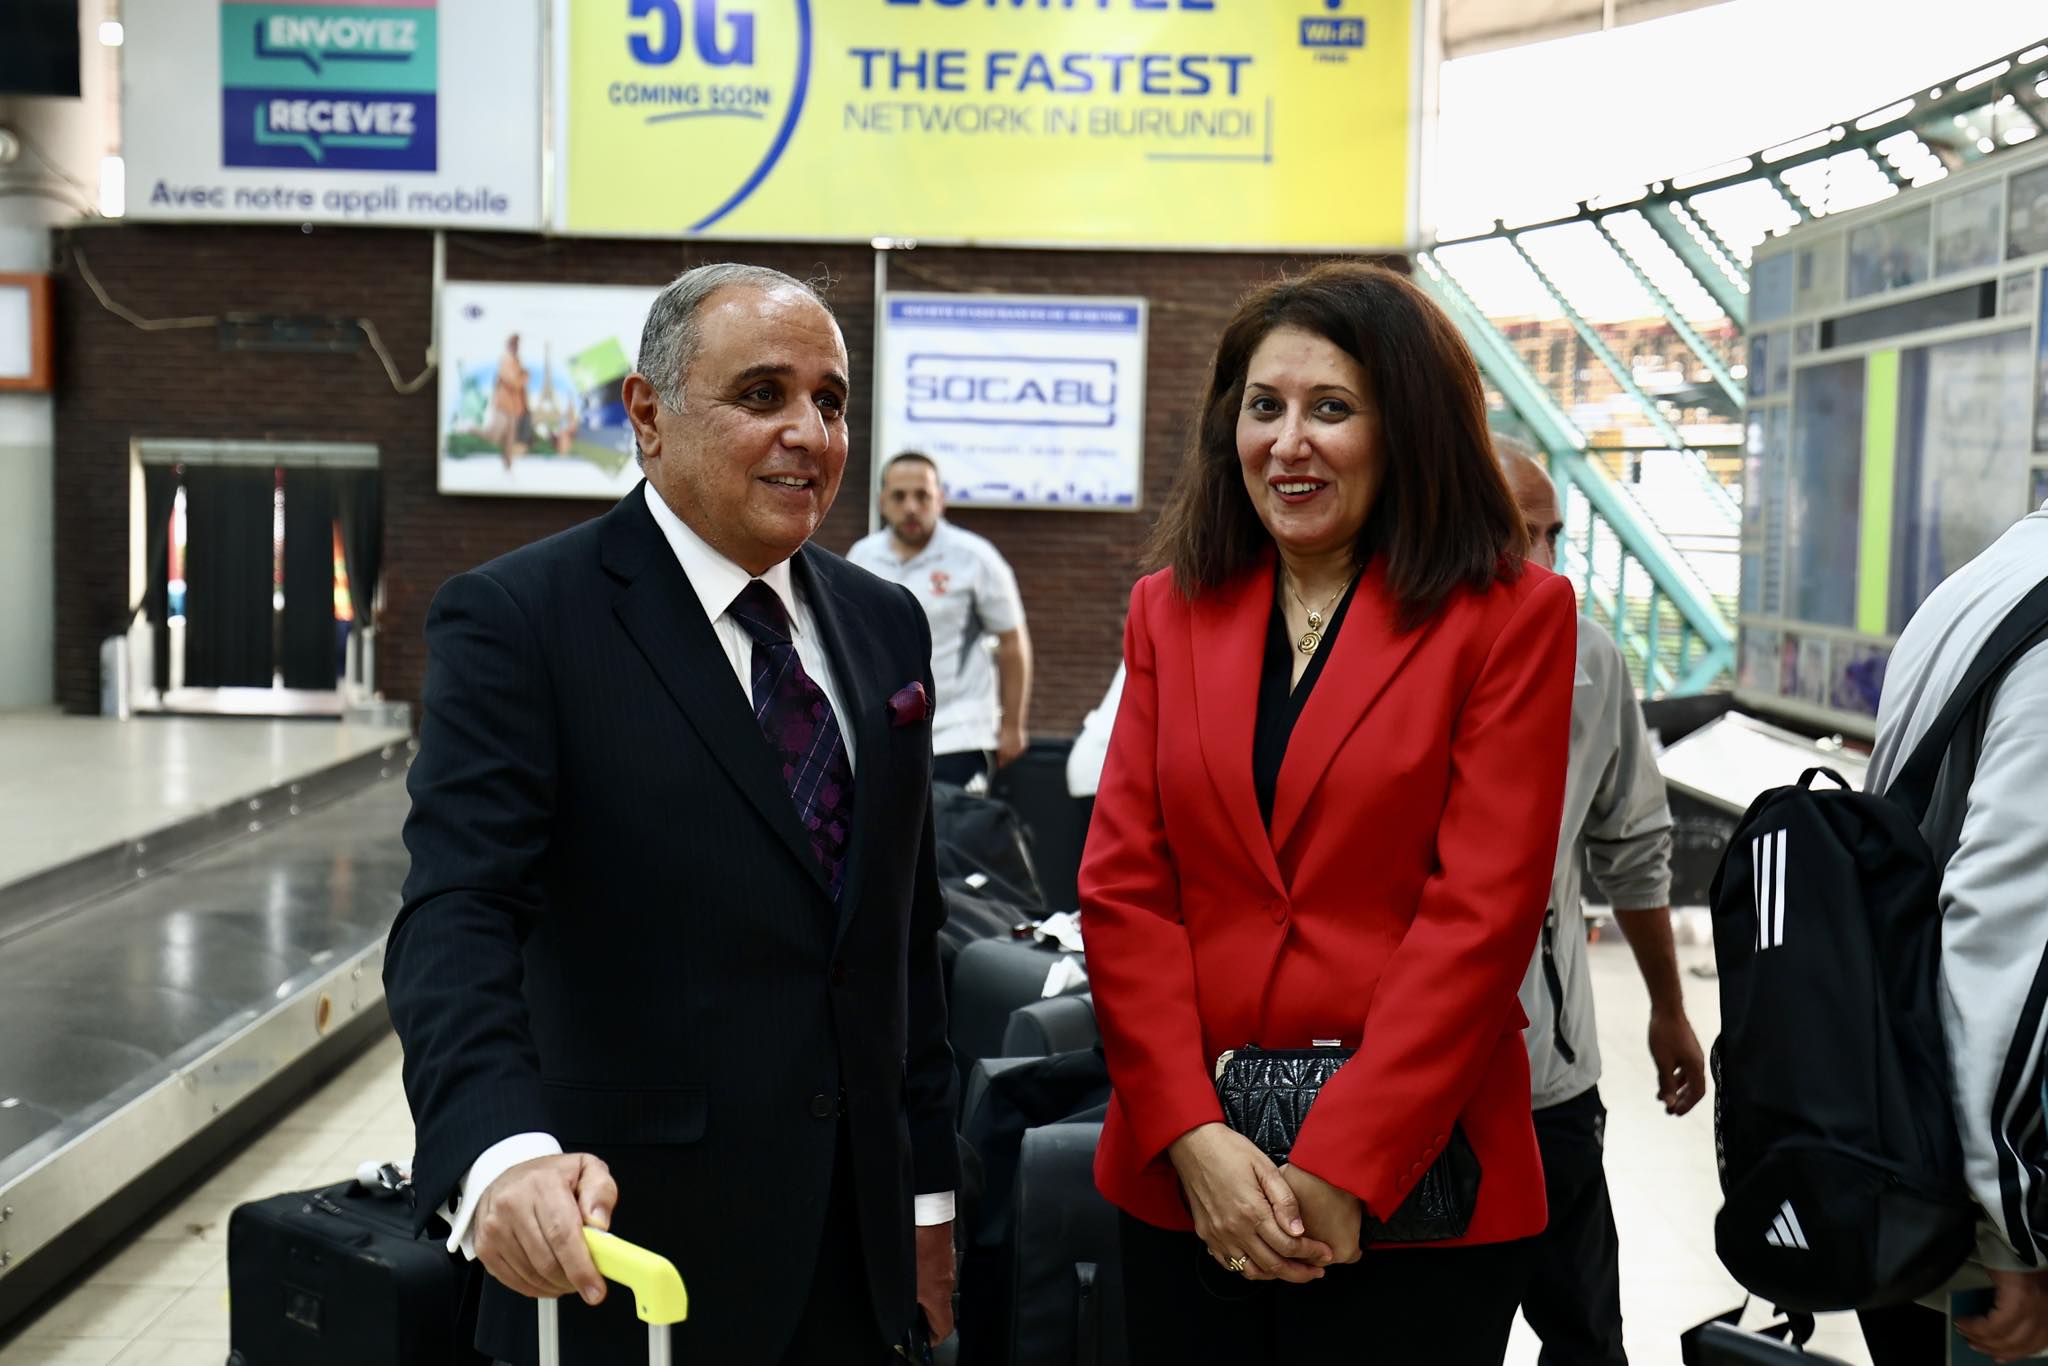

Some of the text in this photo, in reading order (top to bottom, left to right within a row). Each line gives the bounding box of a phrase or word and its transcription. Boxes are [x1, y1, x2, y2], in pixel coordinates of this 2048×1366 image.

[268, 16, 418, 50] ENVOYEZ
[627, 0, 755, 66] 5G
[848, 48, 1253, 96] THE FASTEST
[608, 82, 770, 106] COMING SOON
[269, 100, 416, 134] RECEVEZ
[843, 102, 1253, 138] NETWORK IN BURUNDI
[152, 181, 510, 216] Avec notre appli mobile
[907, 375, 1116, 407] SOCABU
